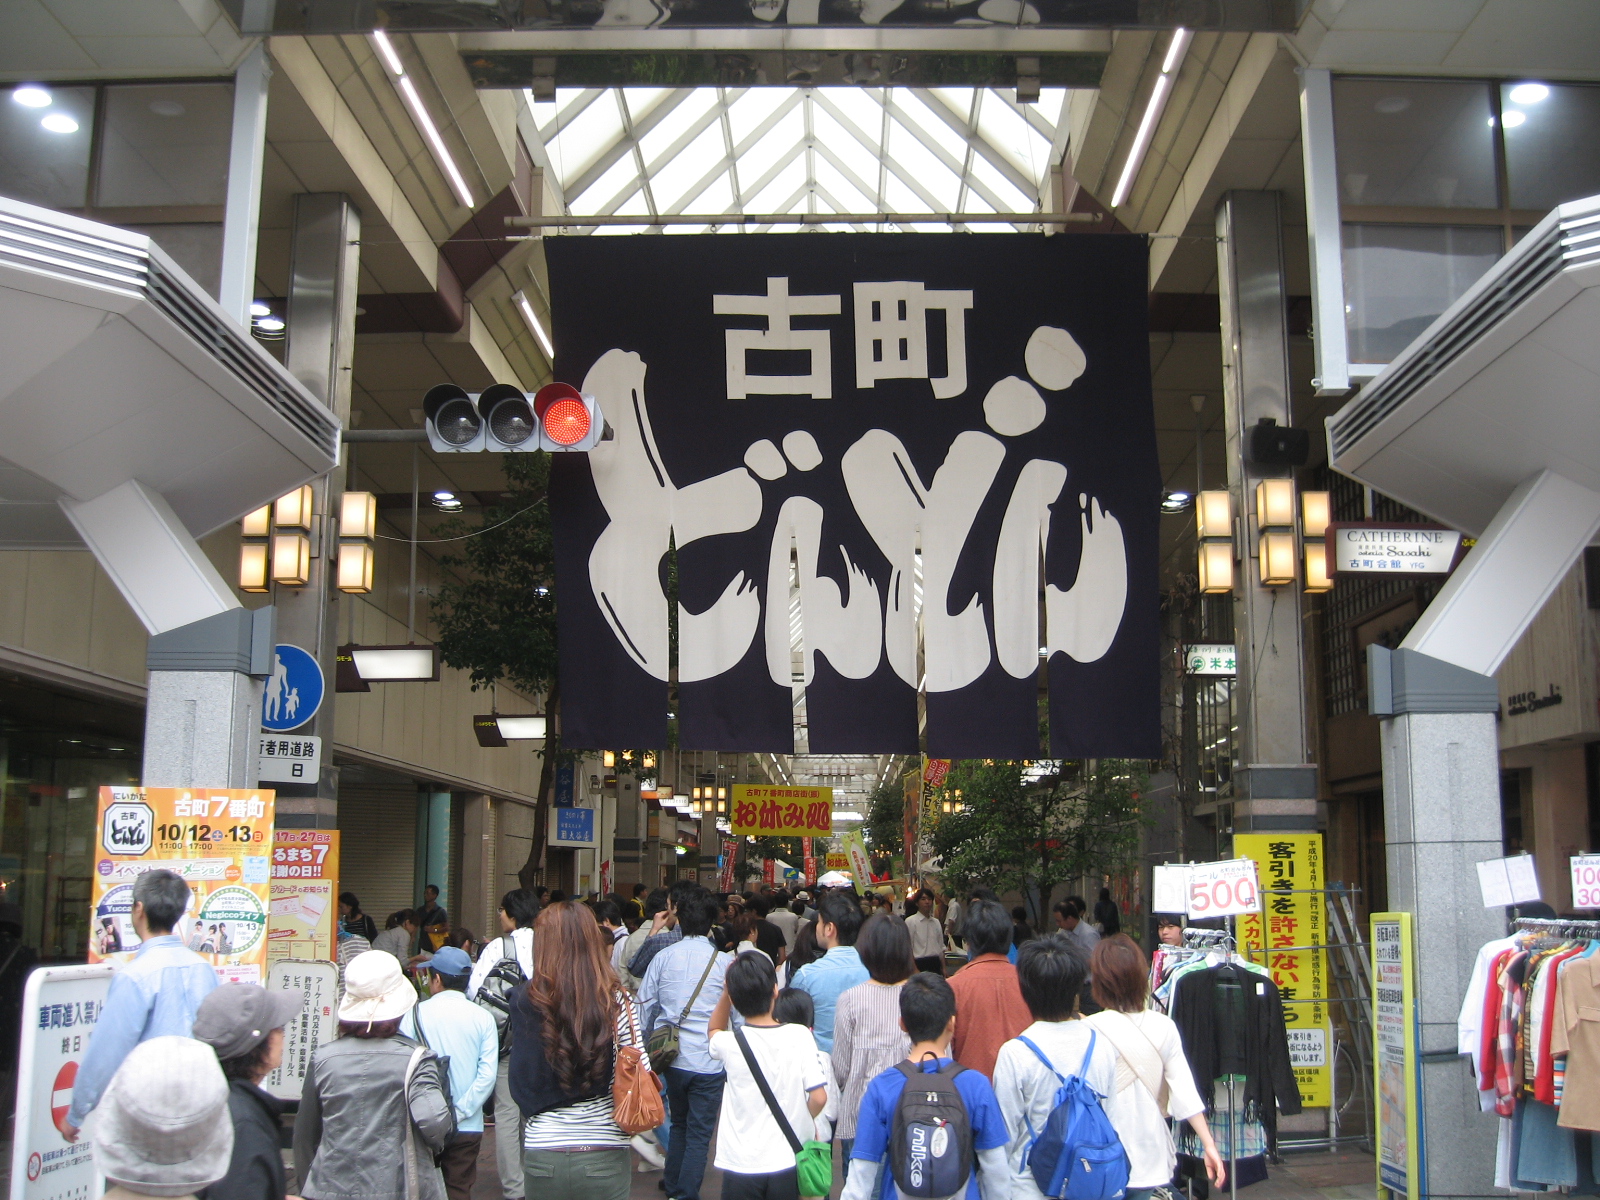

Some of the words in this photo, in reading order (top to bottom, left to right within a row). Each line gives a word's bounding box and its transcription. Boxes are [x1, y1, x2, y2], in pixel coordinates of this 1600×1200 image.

[712, 276, 974, 399] 古町
[580, 324, 1127, 692] どんどん
[1347, 530, 1443, 543] CATHERINE
[1386, 544, 1432, 557] Sasaki
[1349, 558, 1401, 568] 古町会館
[113, 792, 147, 801] にいがた
[120, 811, 138, 821] 古町
[734, 799, 830, 831] お休み処
[272, 844, 329, 864] るまち7
[1268, 841, 1299, 1023] 客引きを許さないまち
[910, 1127, 927, 1188] nike
